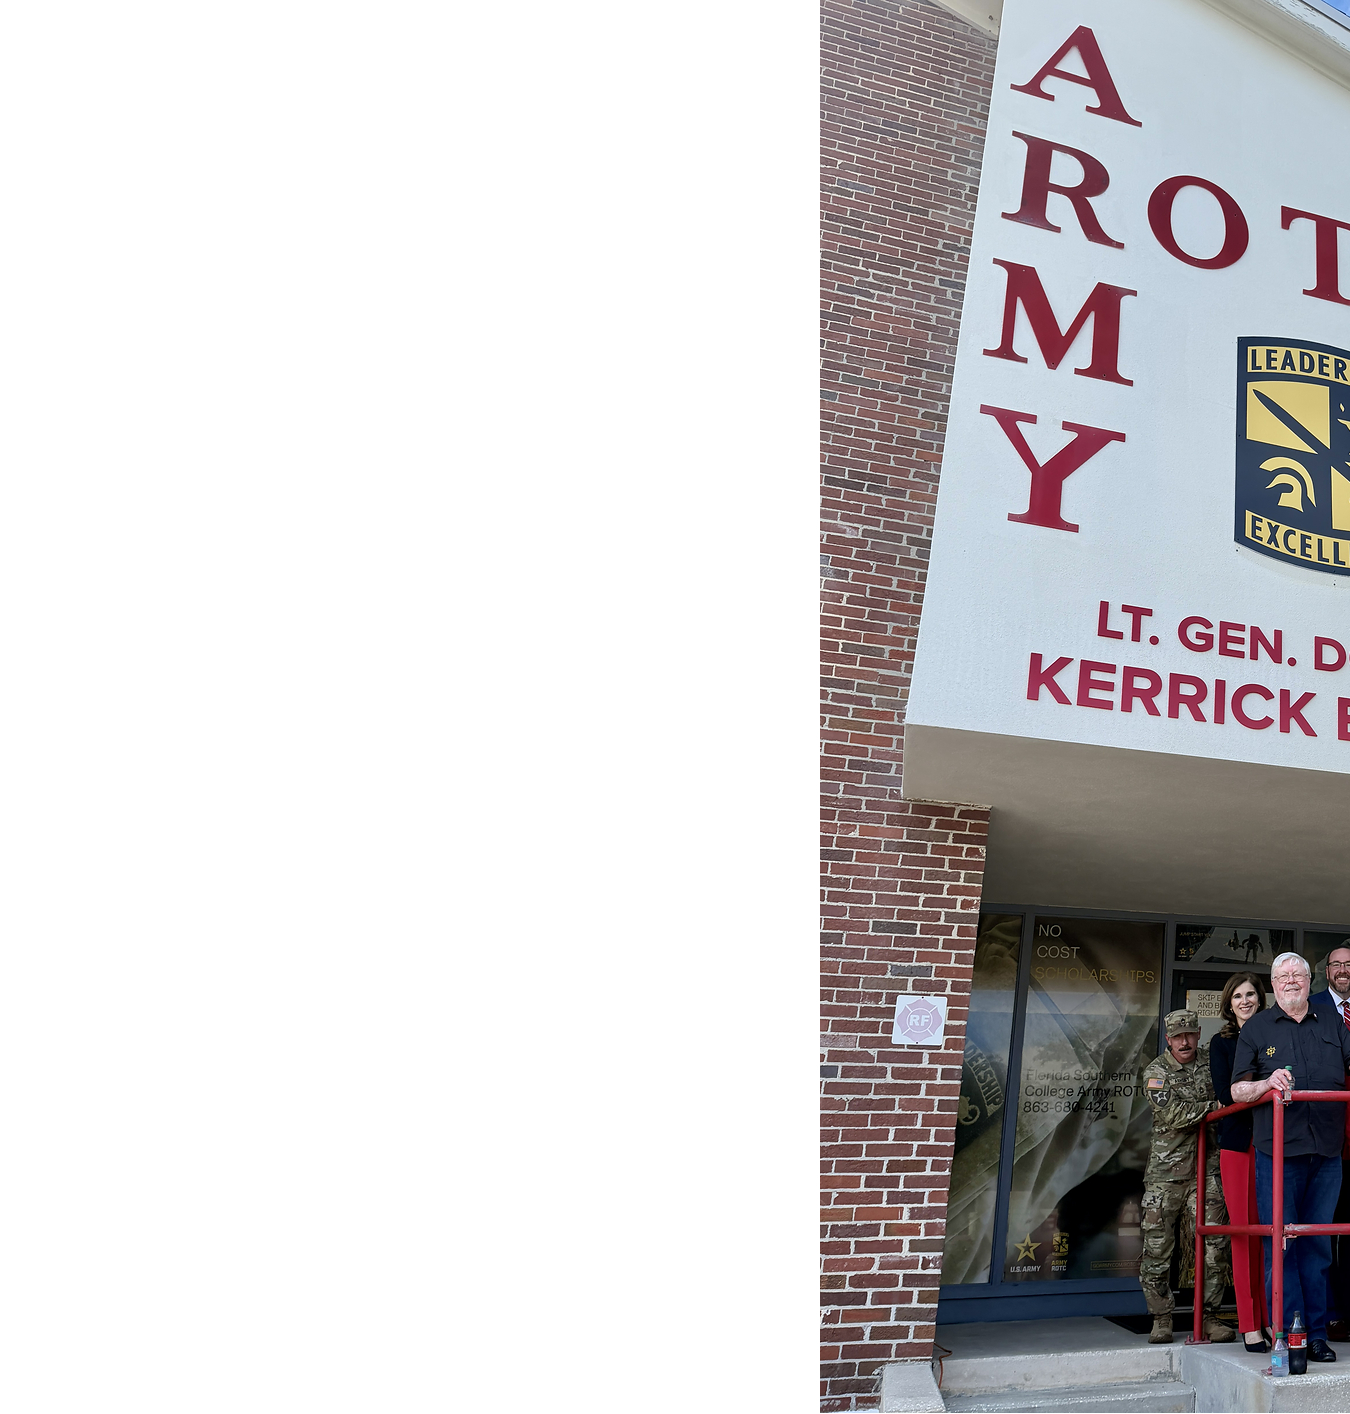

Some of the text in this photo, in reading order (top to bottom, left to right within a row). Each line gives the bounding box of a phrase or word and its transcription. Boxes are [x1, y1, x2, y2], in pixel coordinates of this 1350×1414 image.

[980, 25, 1142, 533] ARMY
[1097, 600, 1160, 646] LT.
[1177, 615, 1298, 667] GEN.
[1026, 652, 1318, 738] KERRICK
[1038, 924, 1062, 938] NO
[1036, 945, 1080, 959] COST
[1034, 966, 1158, 984] SCHOLARSHIPS.
[1197, 994, 1216, 1002] SKIP
[909, 1014, 930, 1027] RF
[963, 1043, 1004, 1107] DERSHIP
[1026, 1069, 1132, 1081] Florida Southern
[1025, 1085, 1075, 1099] College
[1076, 1086, 1114, 1099] Army
[1023, 1101, 1116, 1113] 863-680-4241
[1010, 1264, 1041, 1273] U.S. ARMY
